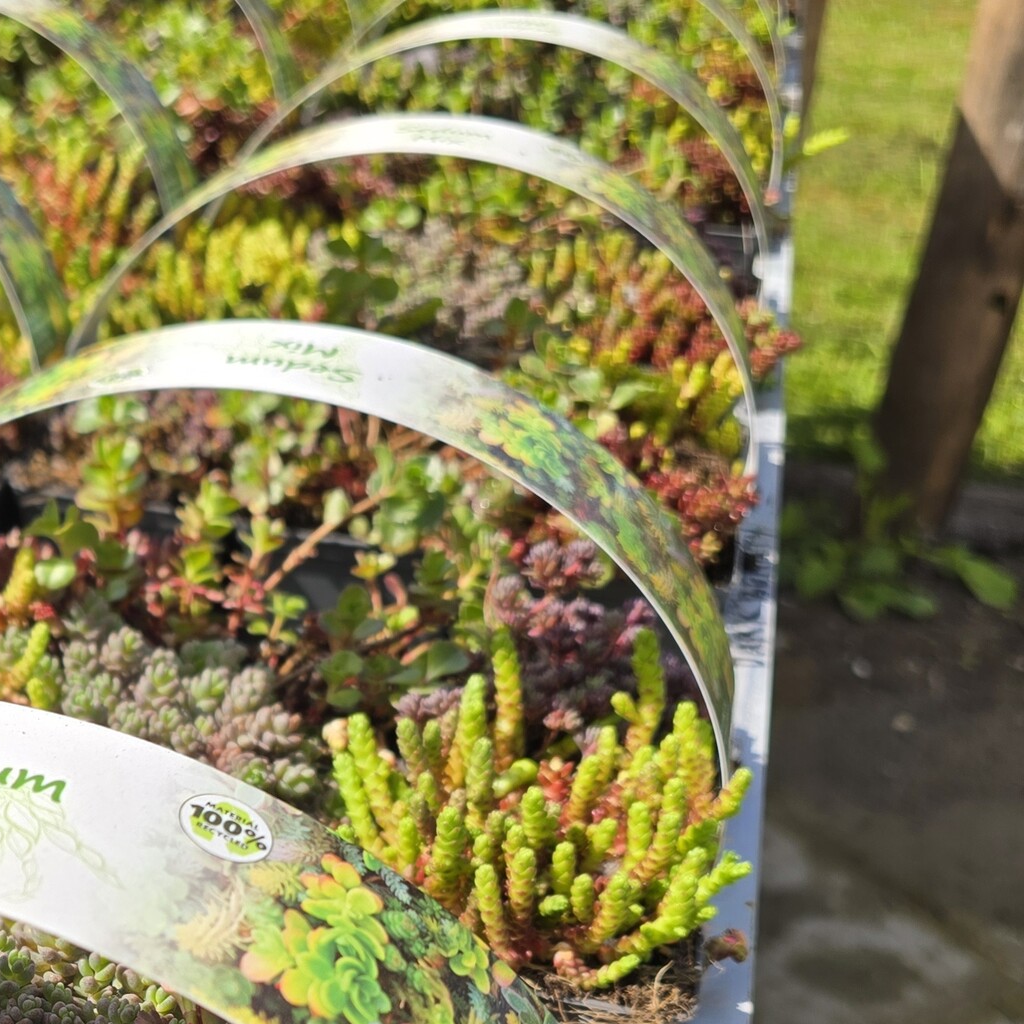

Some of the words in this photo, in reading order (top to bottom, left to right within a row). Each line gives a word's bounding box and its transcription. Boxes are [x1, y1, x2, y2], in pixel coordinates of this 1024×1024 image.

[225, 355, 362, 383] Sedum
[190, 803, 267, 851] 100%
[205, 801, 260, 832] MATERIAL
[196, 821, 249, 850] RECYCLED
